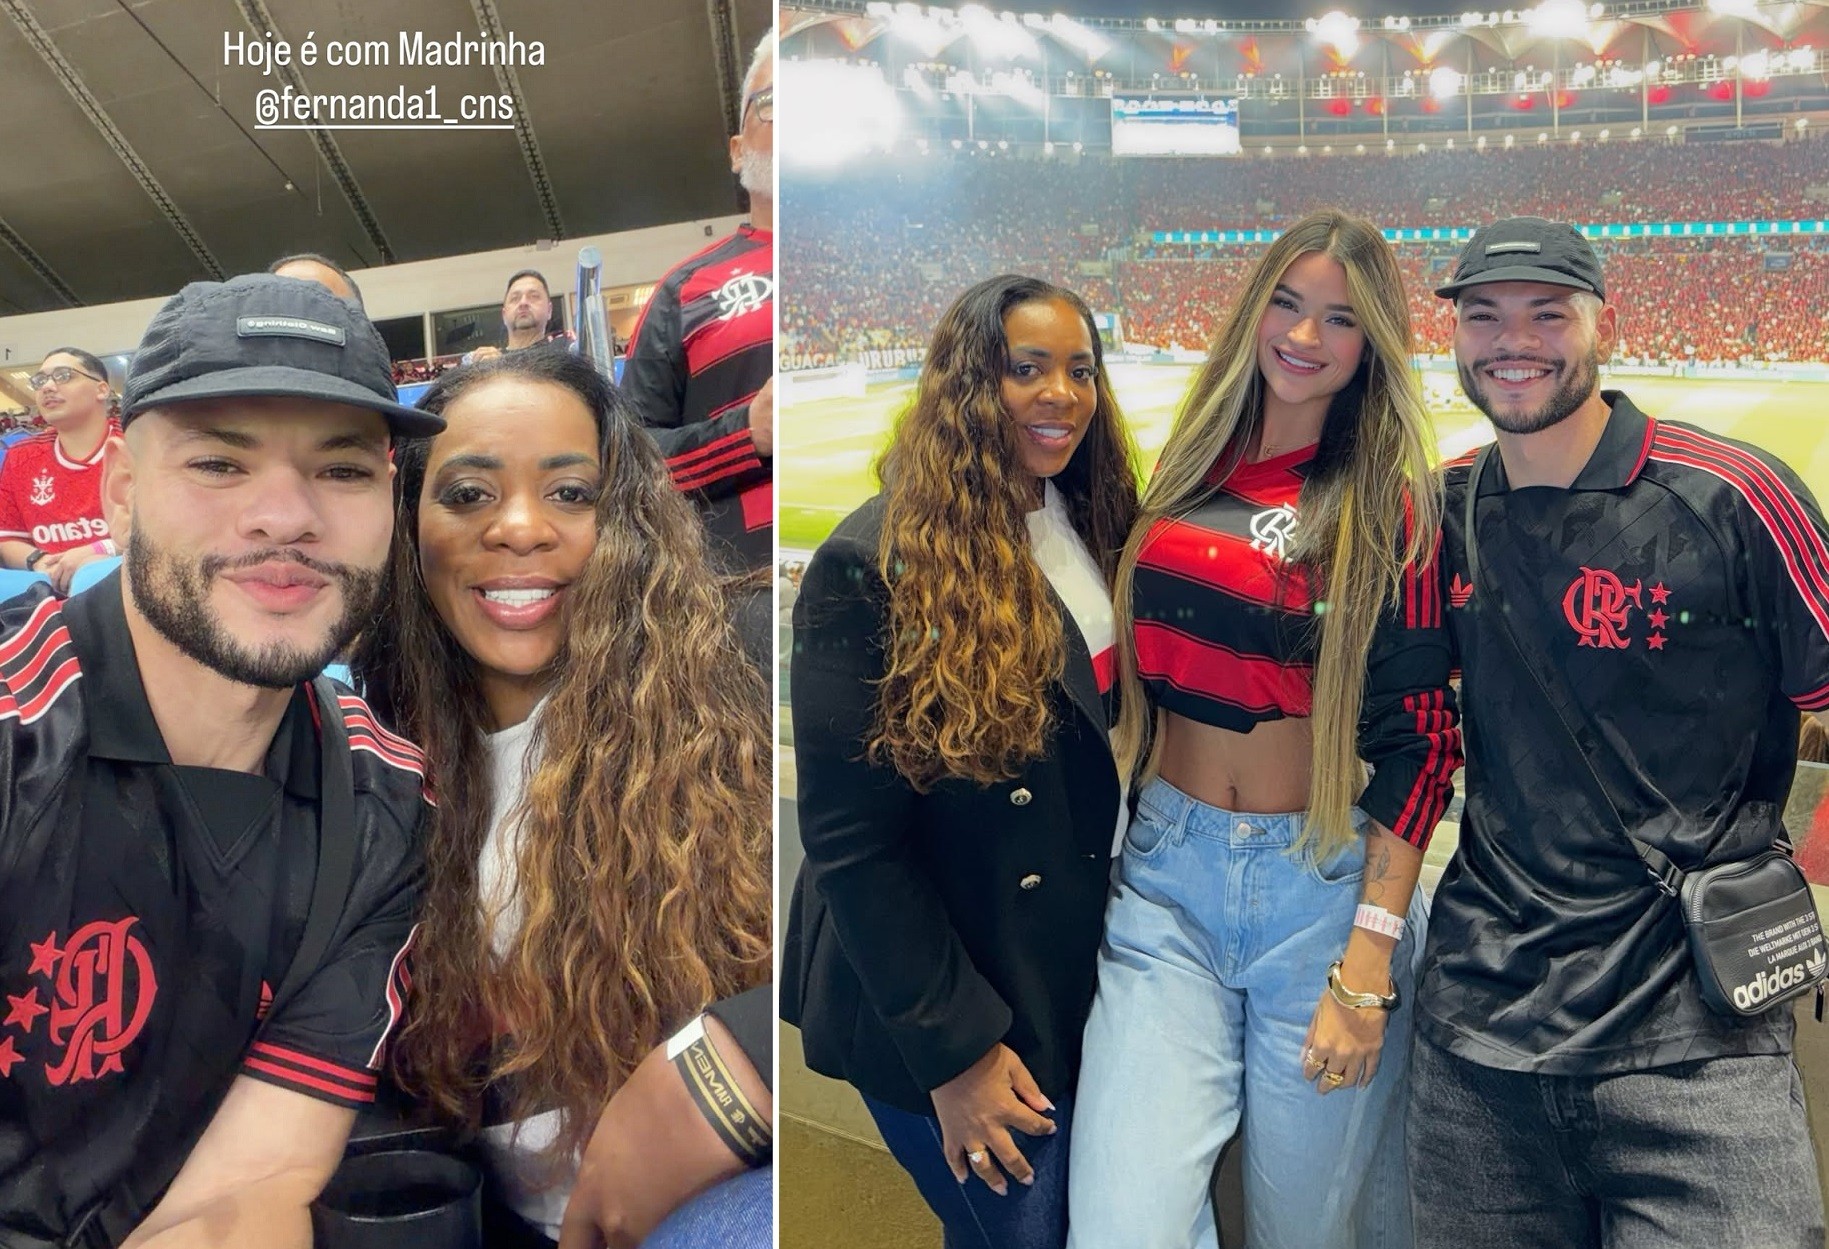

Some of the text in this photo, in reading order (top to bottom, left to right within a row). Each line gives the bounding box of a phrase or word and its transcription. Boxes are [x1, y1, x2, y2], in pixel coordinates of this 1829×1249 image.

[1752, 932, 1765, 942] THE
[1765, 925, 1784, 938] BRAND
[1748, 946, 1760, 957] DIE
[1767, 954, 1776, 964] LA
[1733, 963, 1805, 1010] adidas
